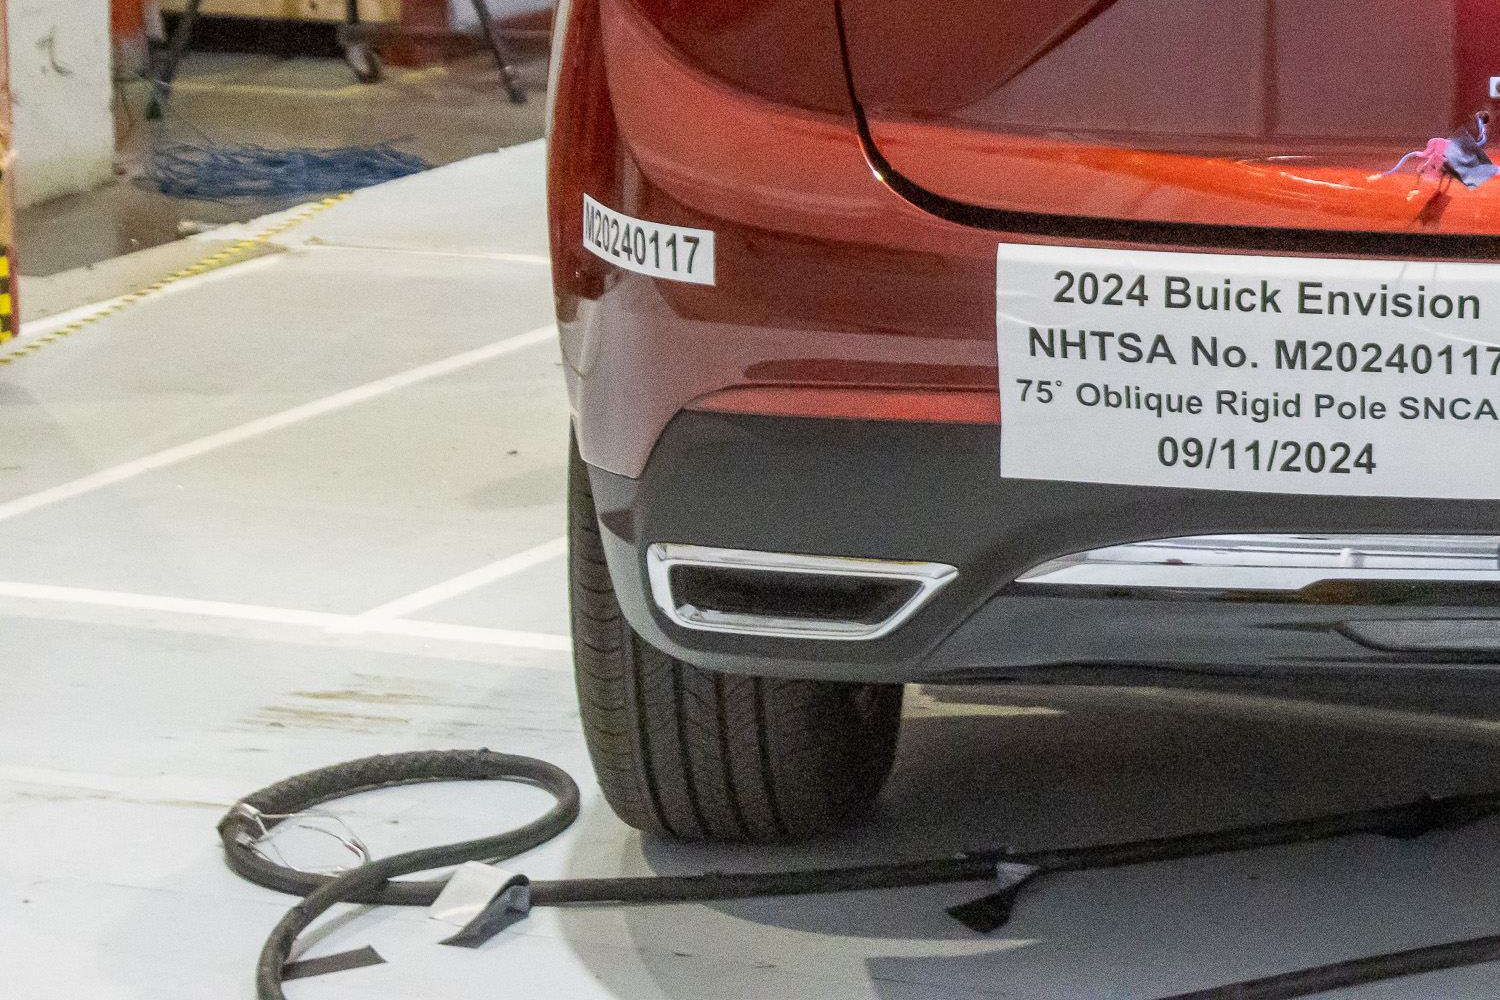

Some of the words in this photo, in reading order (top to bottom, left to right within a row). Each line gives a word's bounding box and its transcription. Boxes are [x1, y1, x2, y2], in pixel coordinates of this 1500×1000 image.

[584, 202, 700, 274] M20240117
[1052, 269, 1149, 308] 2024
[1163, 275, 1282, 314] Buick
[1297, 281, 1481, 320] Envision
[1028, 327, 1176, 365] NHTSA
[1191, 335, 1259, 369] No.
[1015, 379, 1064, 405] 75°
[1075, 382, 1203, 417] Oblique
[1215, 389, 1302, 423] Rigid
[1313, 393, 1387, 420] Pole
[1157, 436, 1377, 475] 09/11/2024
